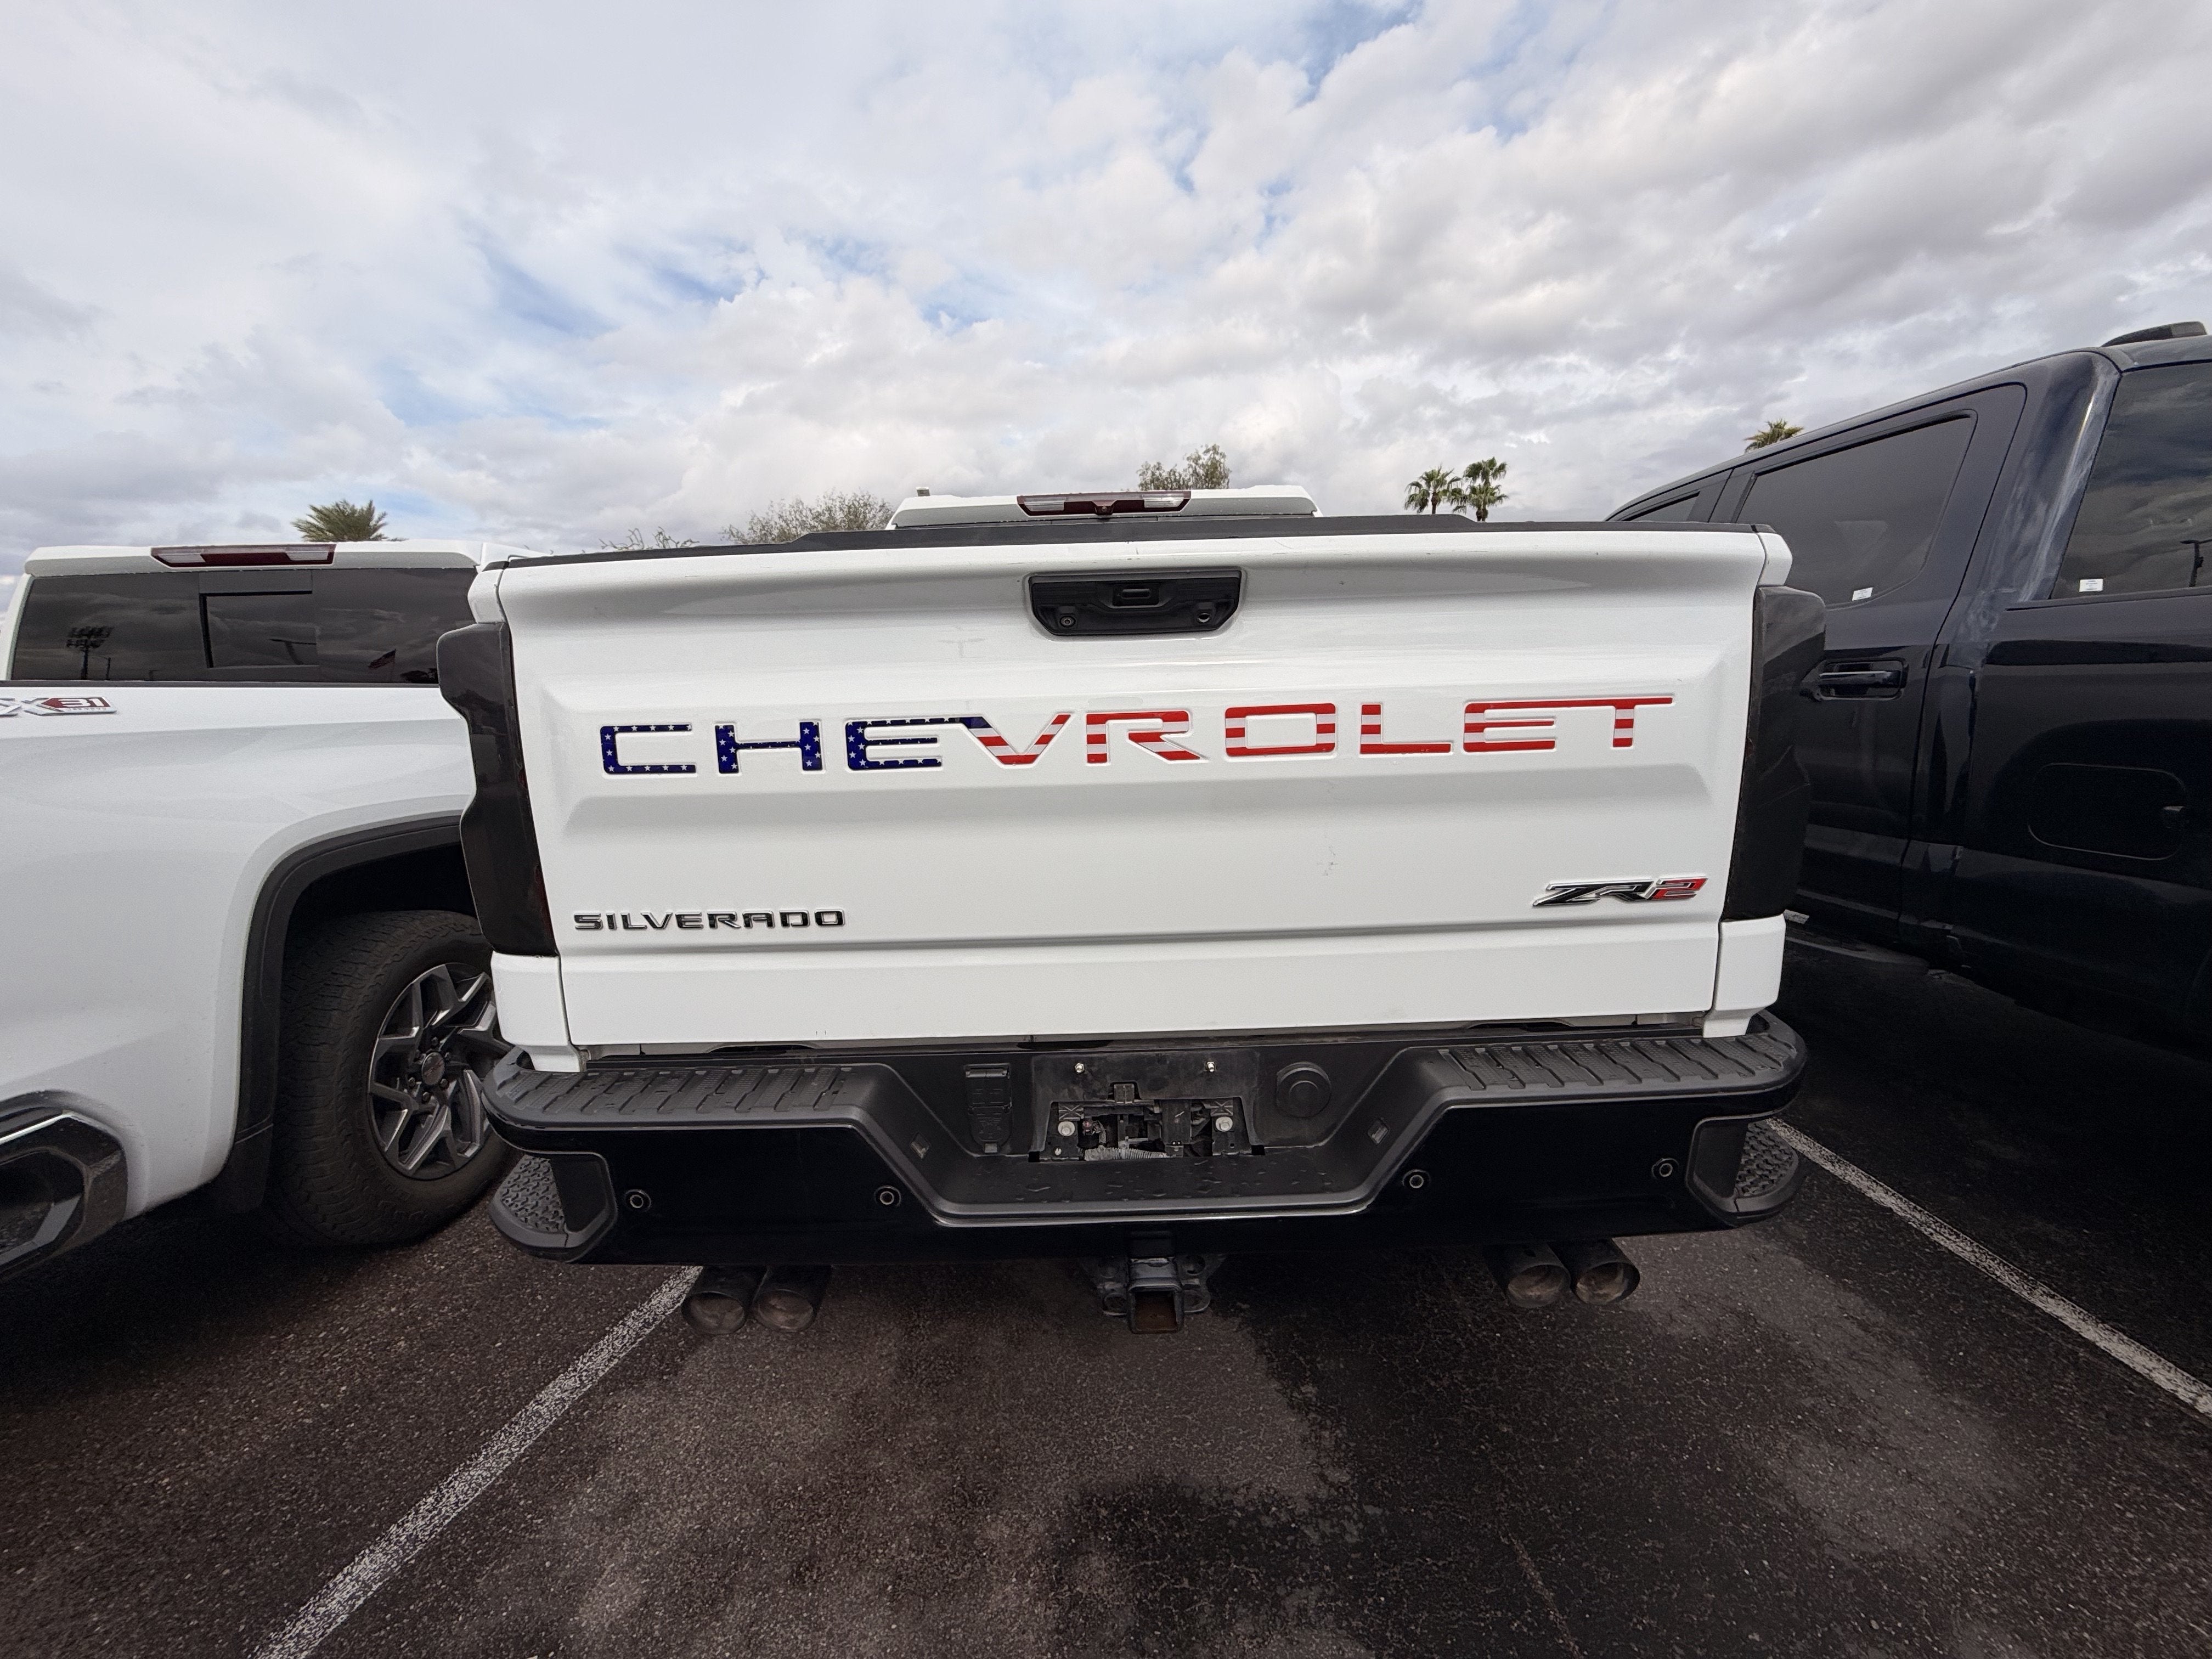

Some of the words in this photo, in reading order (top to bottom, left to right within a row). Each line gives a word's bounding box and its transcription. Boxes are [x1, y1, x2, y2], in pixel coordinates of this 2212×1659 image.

[601, 695, 1674, 774] CHEVROLET
[1533, 876, 1709, 906] ZR2
[573, 909, 845, 930] SILVERADO
